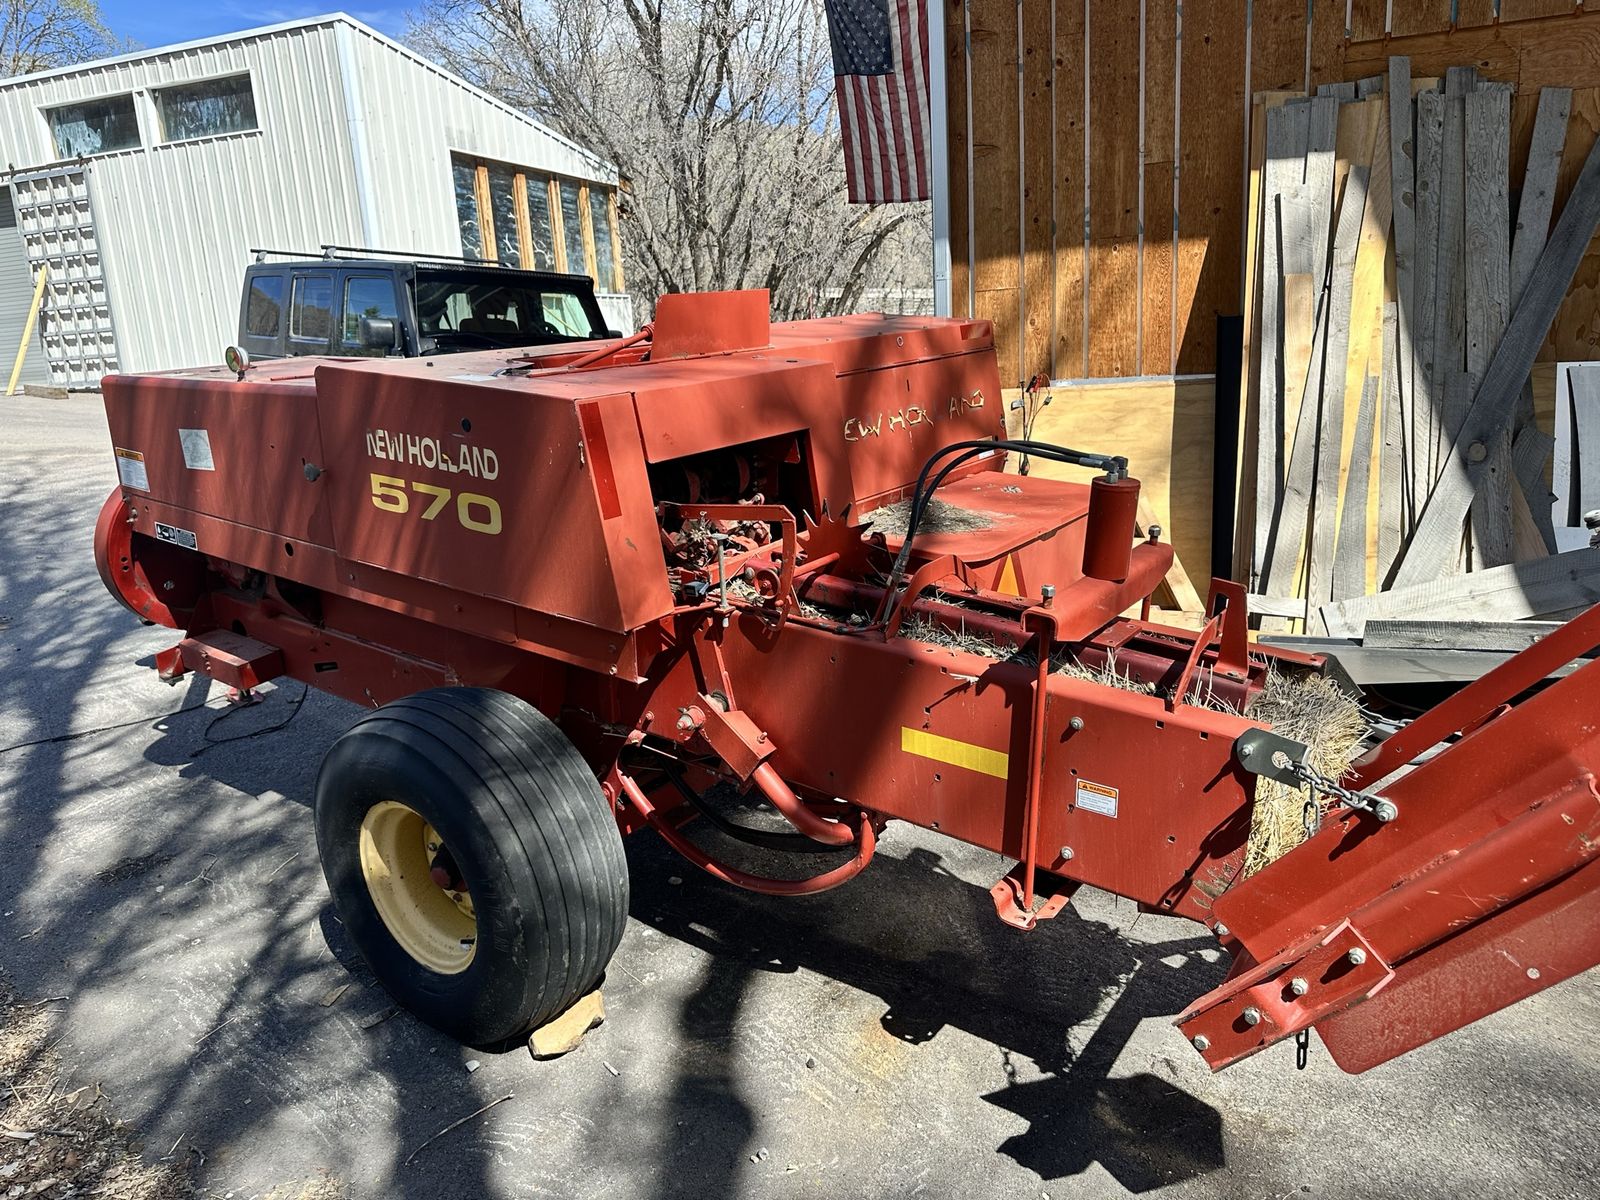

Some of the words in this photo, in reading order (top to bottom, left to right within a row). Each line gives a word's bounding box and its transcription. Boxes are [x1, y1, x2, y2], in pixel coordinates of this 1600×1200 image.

[366, 429, 404, 463] NEW
[406, 434, 499, 481] HOLLAND
[370, 473, 502, 536] 570
